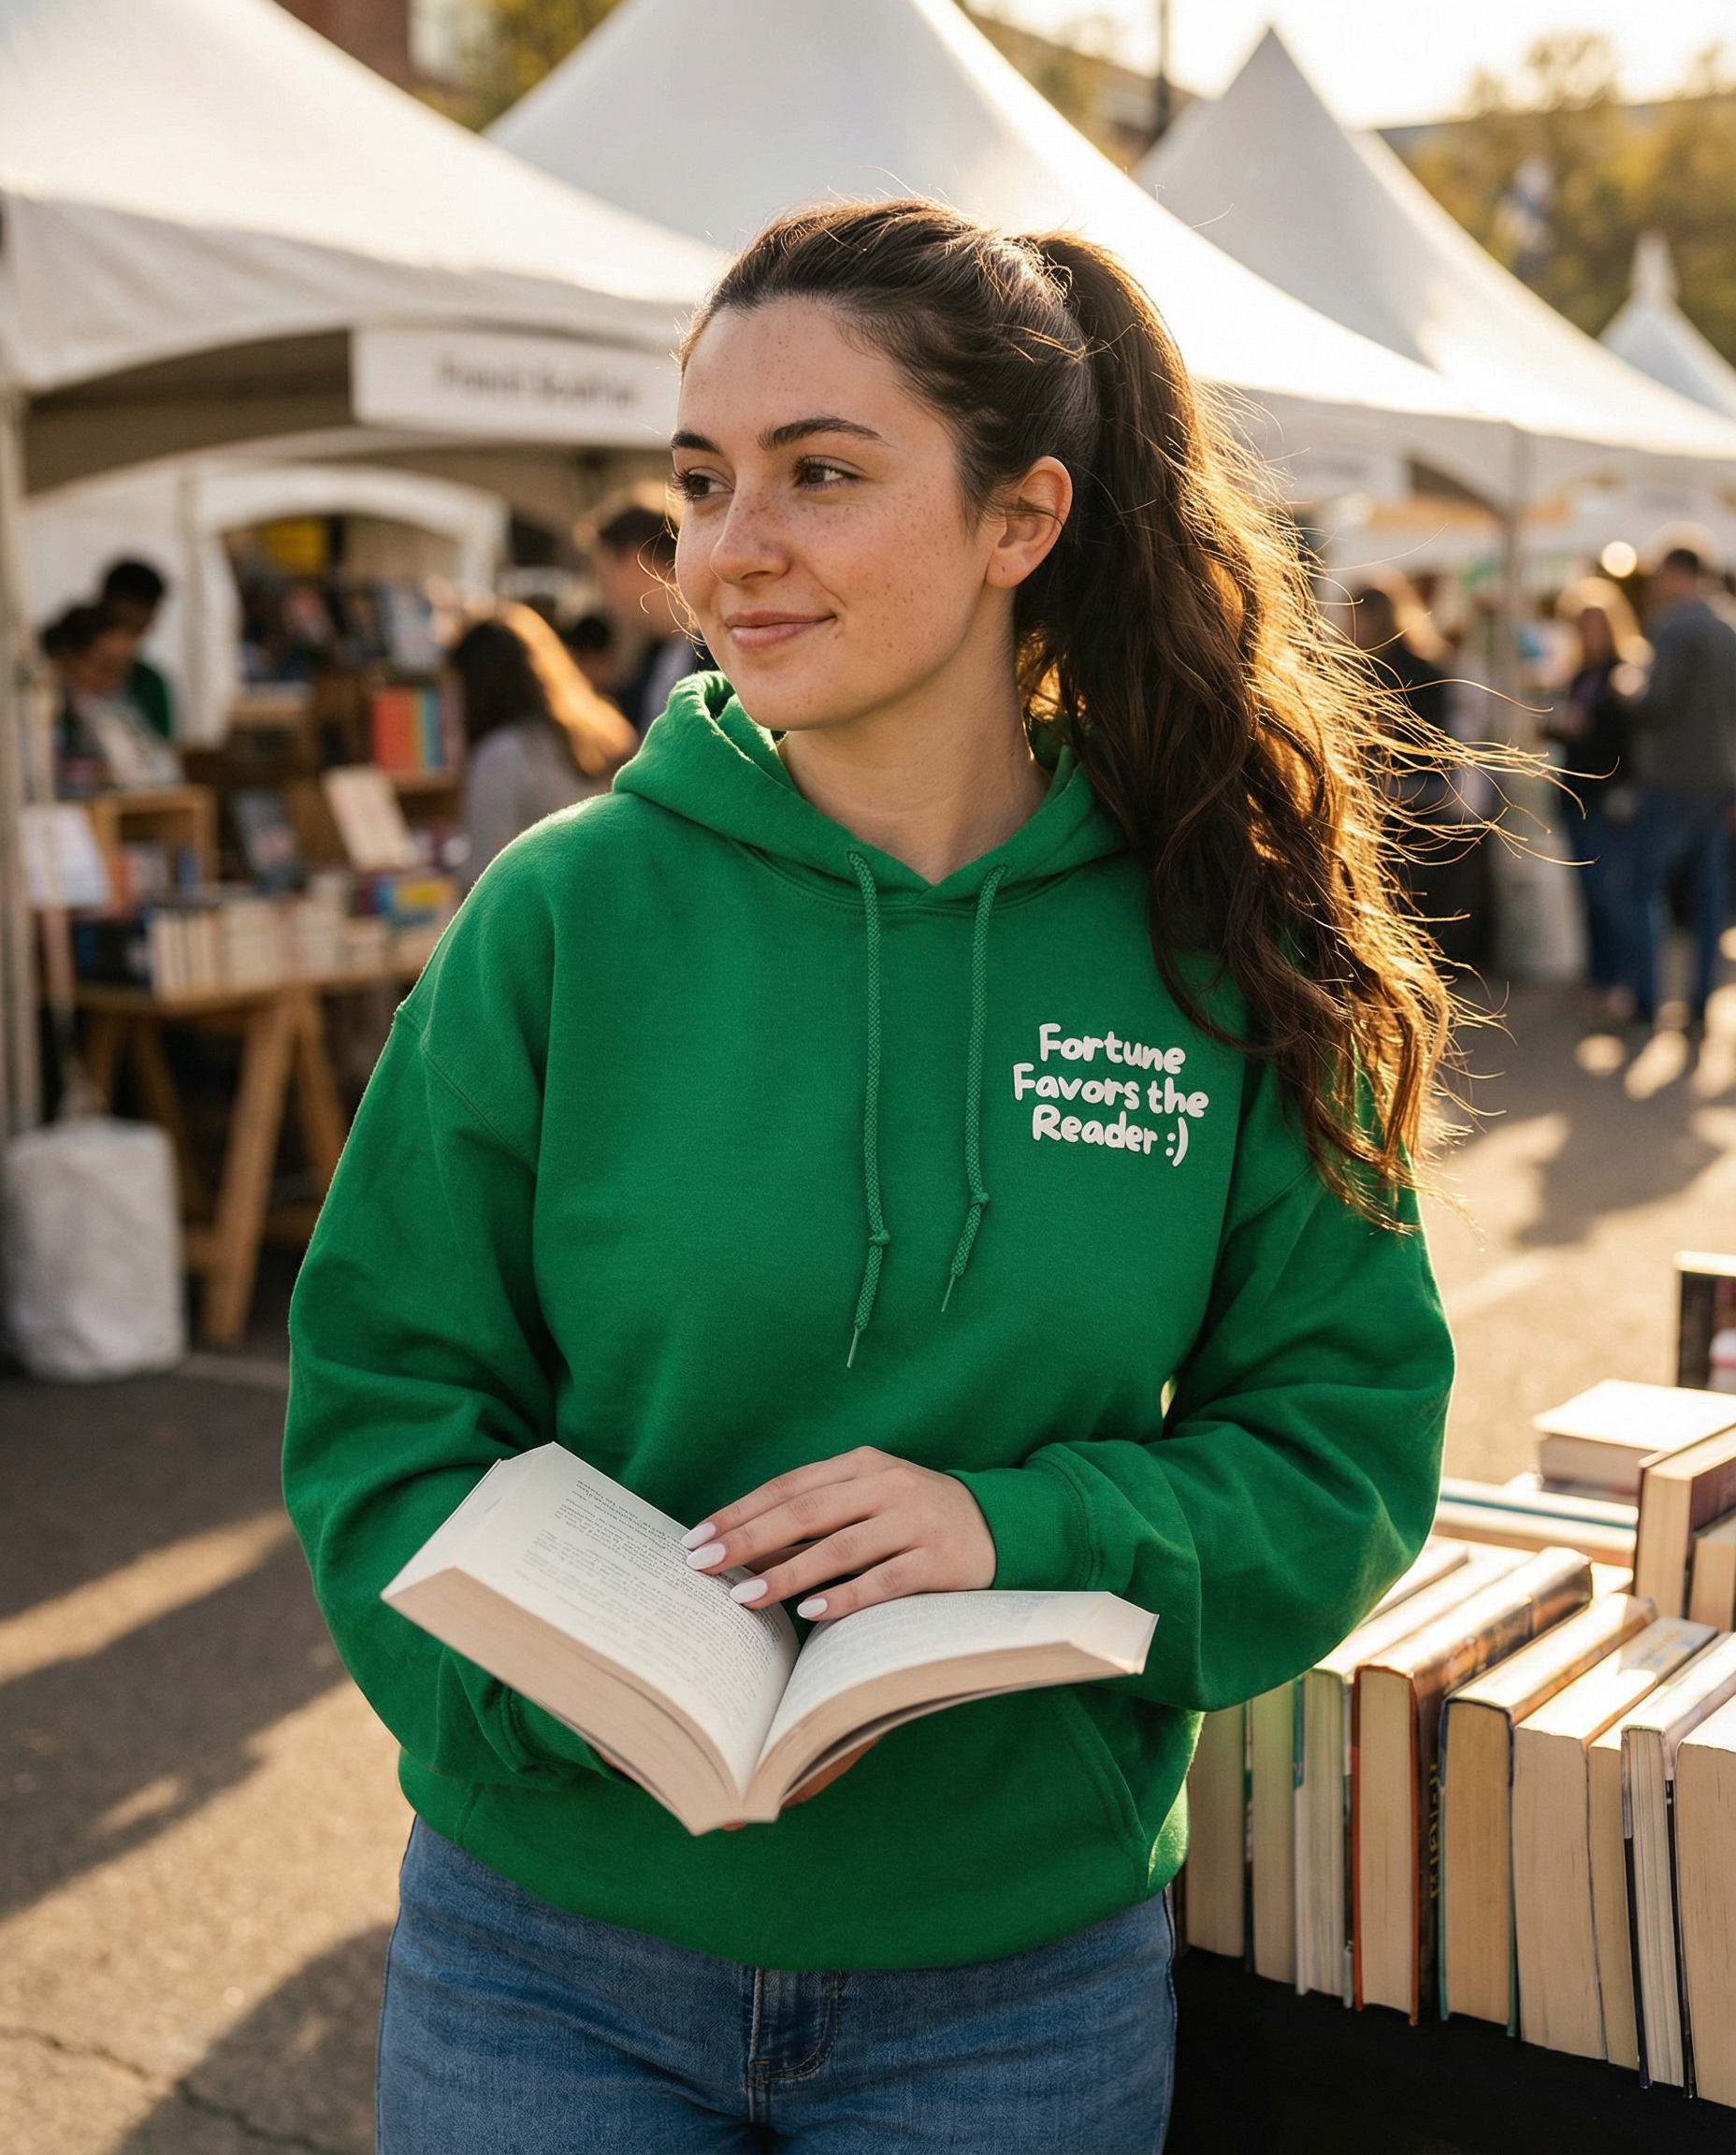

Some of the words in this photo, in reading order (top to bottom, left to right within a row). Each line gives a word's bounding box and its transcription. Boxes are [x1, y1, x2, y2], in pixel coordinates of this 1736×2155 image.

[1039, 1023, 1186, 1075] Fortune
[1013, 1063, 1140, 1110] Favors
[1147, 1077, 1209, 1118] the
[1033, 1104, 1158, 1155] Reader
